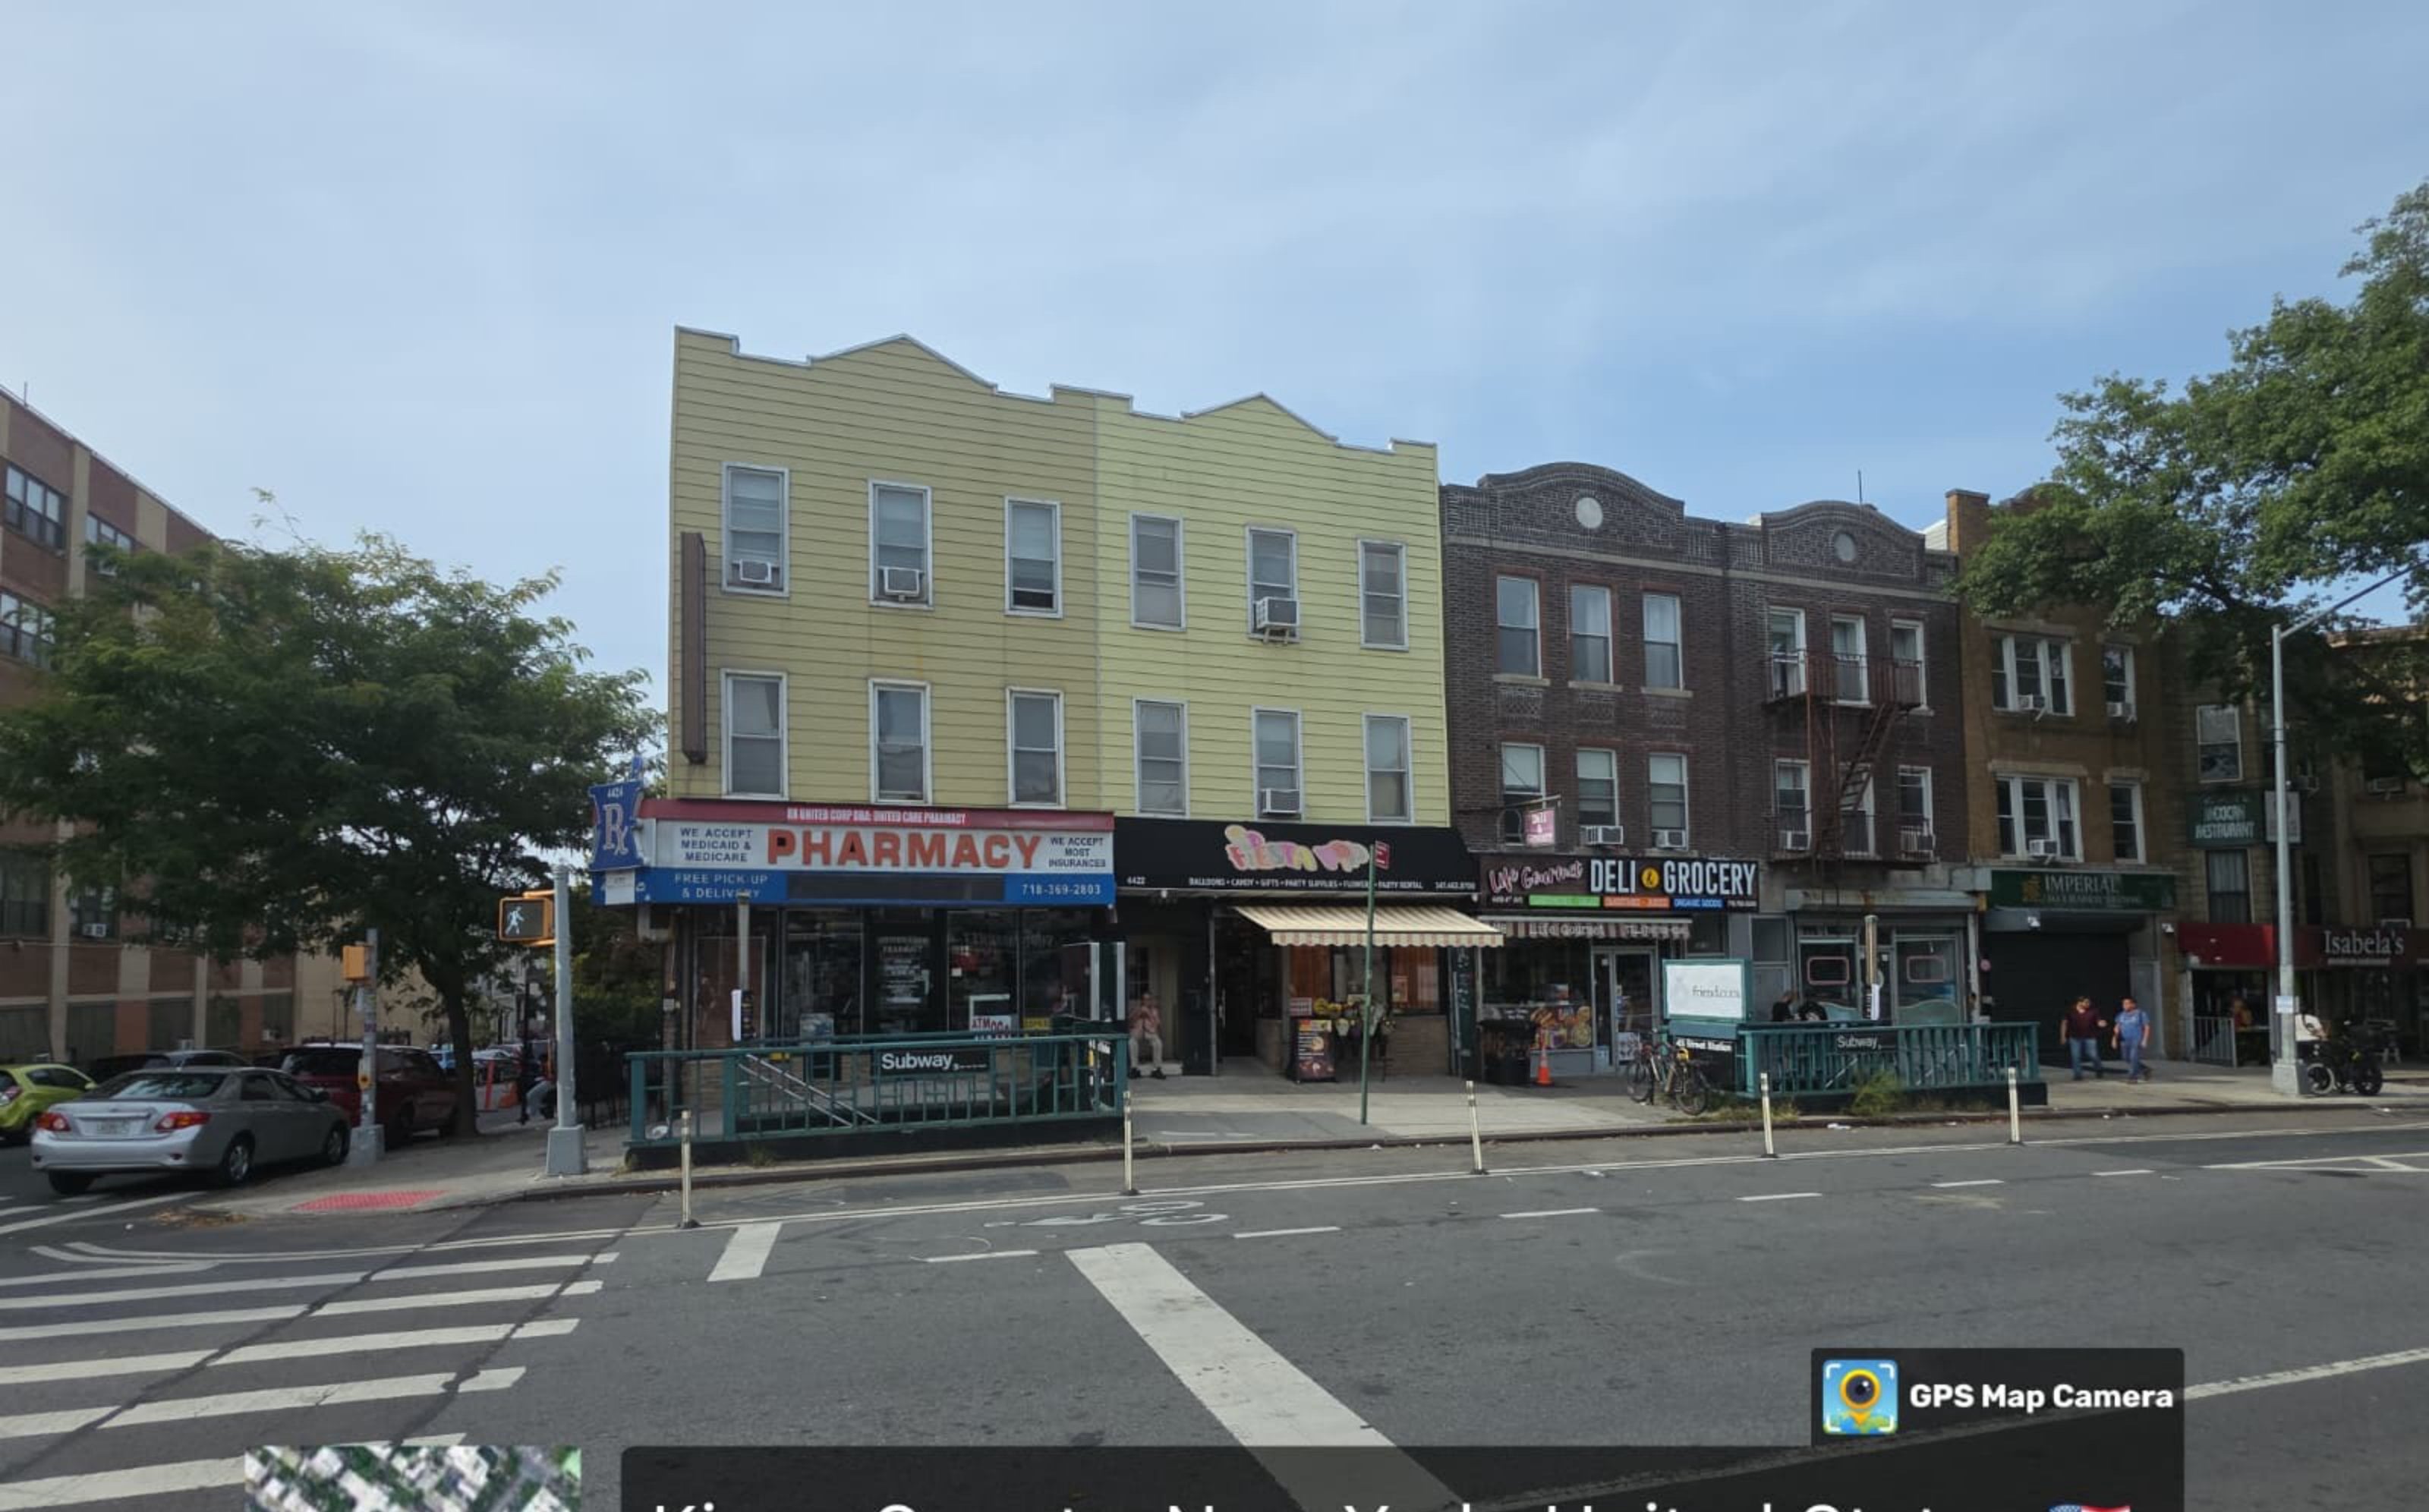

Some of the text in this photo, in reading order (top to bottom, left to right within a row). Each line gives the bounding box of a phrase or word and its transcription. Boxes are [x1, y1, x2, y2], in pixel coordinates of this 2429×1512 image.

[680, 828, 753, 839] WE ACCEPT
[681, 840, 752, 850] MEDICAID &
[1051, 837, 1104, 846] WE ACCEPT
[767, 828, 1041, 869] PHARMACY
[1065, 849, 1090, 857] MOST
[685, 852, 748, 862] MEDICARE
[1048, 858, 1106, 868] INSURANCES
[675, 873, 708, 884] FREE
[1189, 877, 1225, 886] BALLOONS
[1231, 877, 1252, 887] CANDY
[1260, 878, 1279, 887] GIFTS
[1285, 878, 1306, 887] PARTY
[1378, 880, 1397, 889] PARTY
[1521, 860, 1583, 889] Gourmet
[1590, 859, 1636, 893] DELI
[1664, 861, 1756, 896] GROCERY
[2045, 874, 2119, 893] IMPERIAL
[1022, 884, 1101, 896] 718-369-2803
[2323, 930, 2405, 955] Isabela's
[1837, 1036, 1877, 1050] Subway
[881, 1052, 953, 1070] Subway
